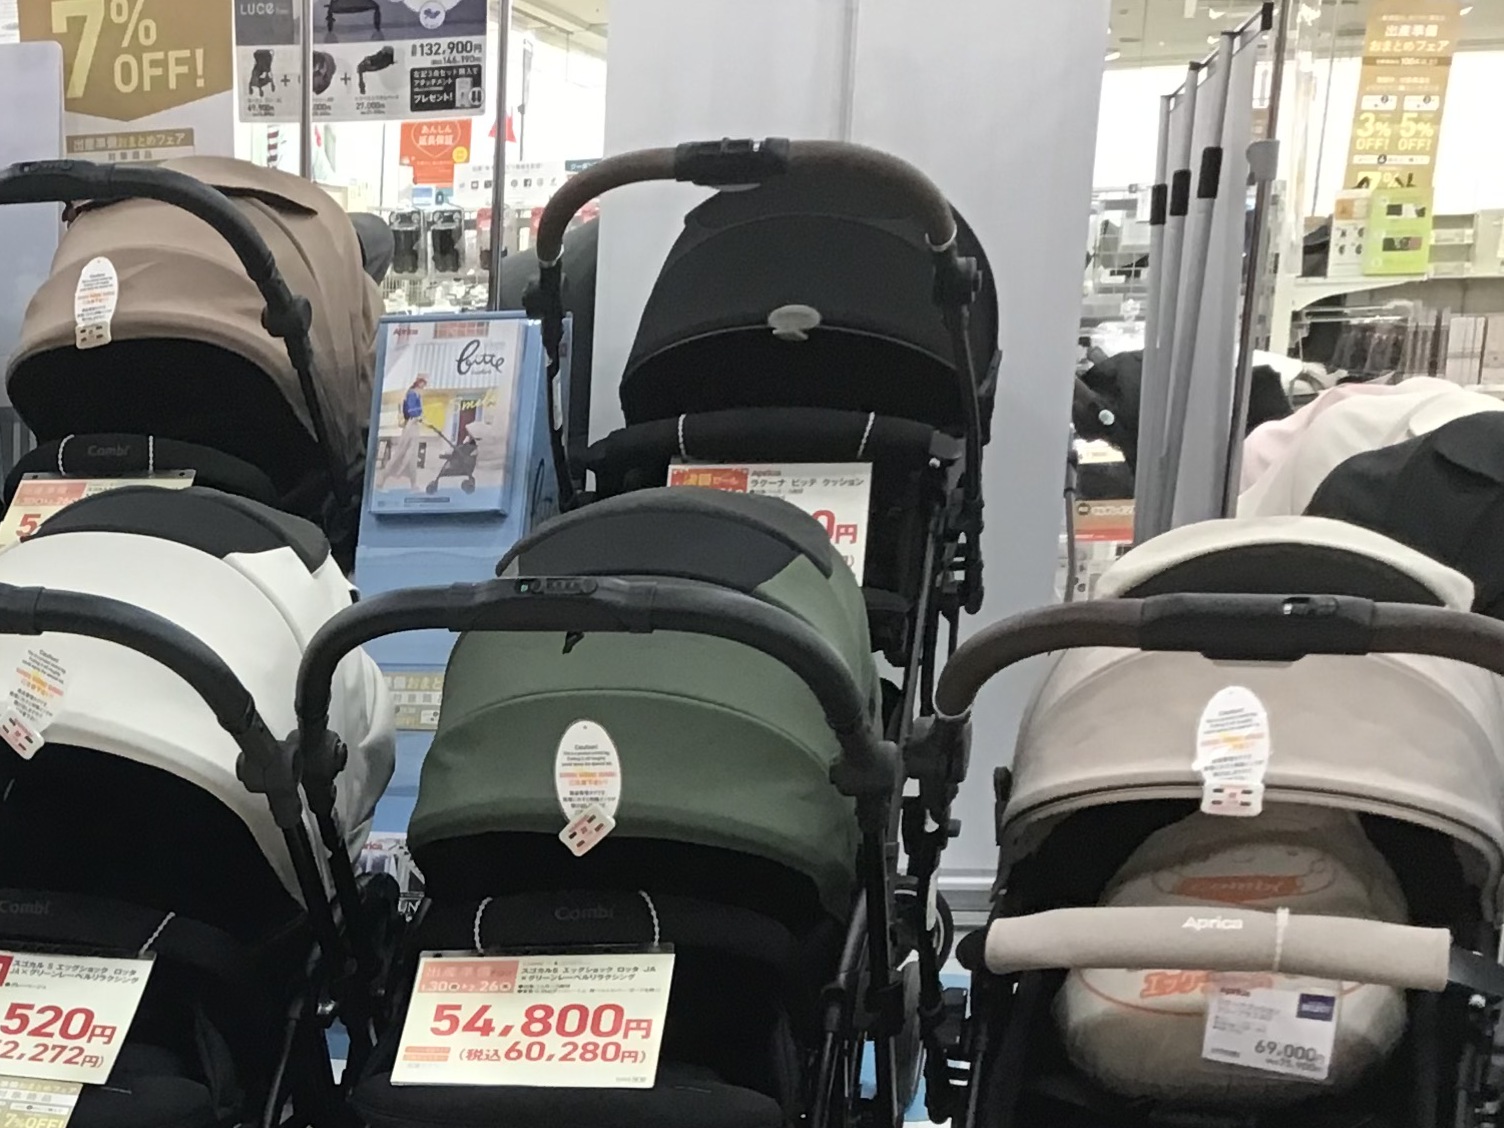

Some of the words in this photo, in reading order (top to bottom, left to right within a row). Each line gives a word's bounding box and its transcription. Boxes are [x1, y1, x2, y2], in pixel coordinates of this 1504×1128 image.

[1369, 40, 1449, 52] おまとめフェア
[114, 48, 204, 93] OFF!
[421, 125, 453, 134] あんしん
[1356, 112, 1392, 137] 3%
[1400, 112, 1434, 138] 5%
[1356, 138, 1390, 150] OFF!
[1398, 138, 1432, 151] OFF!
[1181, 916, 1244, 931] Aprica
[13, 960, 45, 969] スゴカル
[430, 1003, 653, 1040] 54,800円
